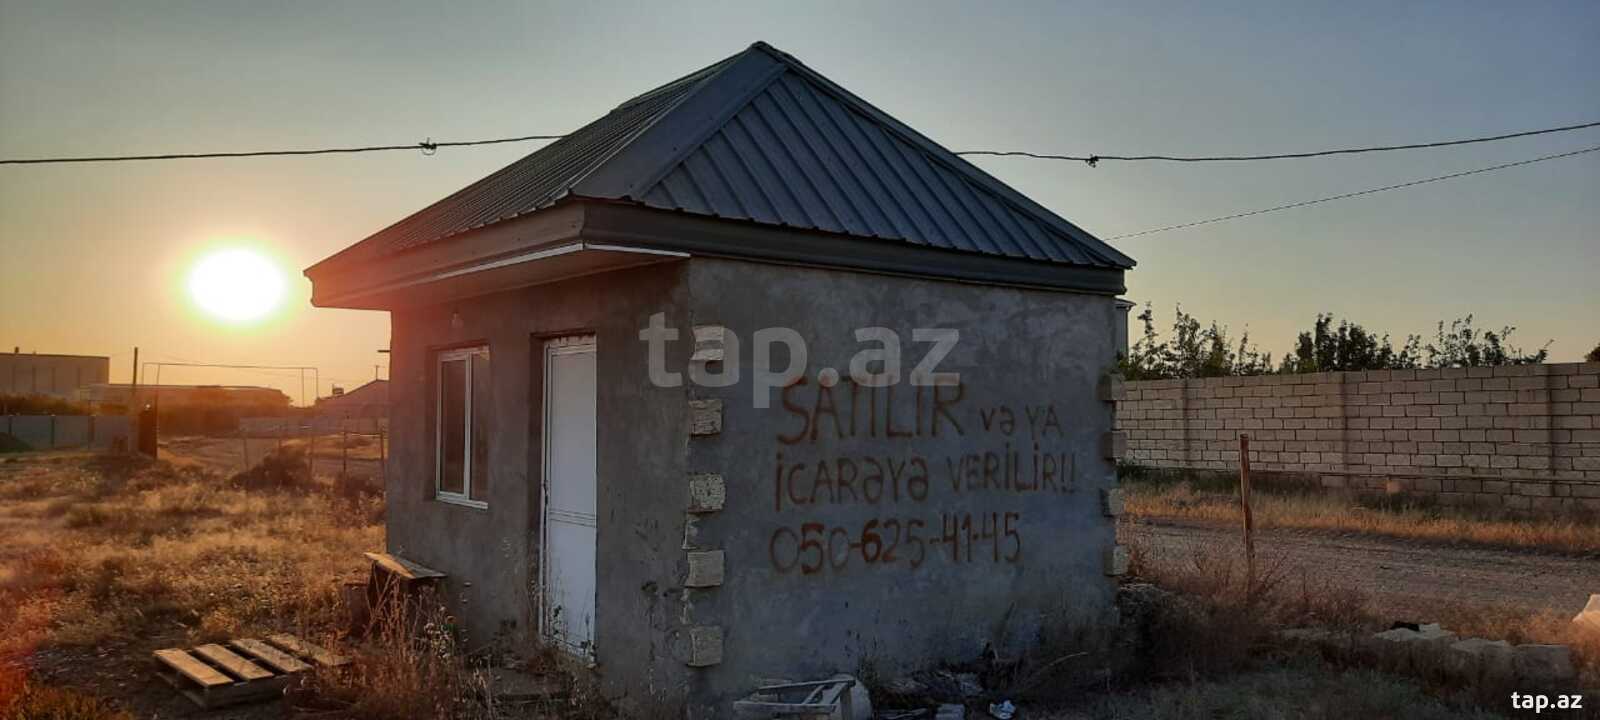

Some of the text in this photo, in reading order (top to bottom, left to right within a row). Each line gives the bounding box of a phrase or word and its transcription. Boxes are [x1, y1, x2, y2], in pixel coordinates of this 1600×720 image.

[776, 372, 970, 446] SATILIR
[1024, 403, 1066, 441] YA
[768, 510, 1022, 576] 050-625-41-45
